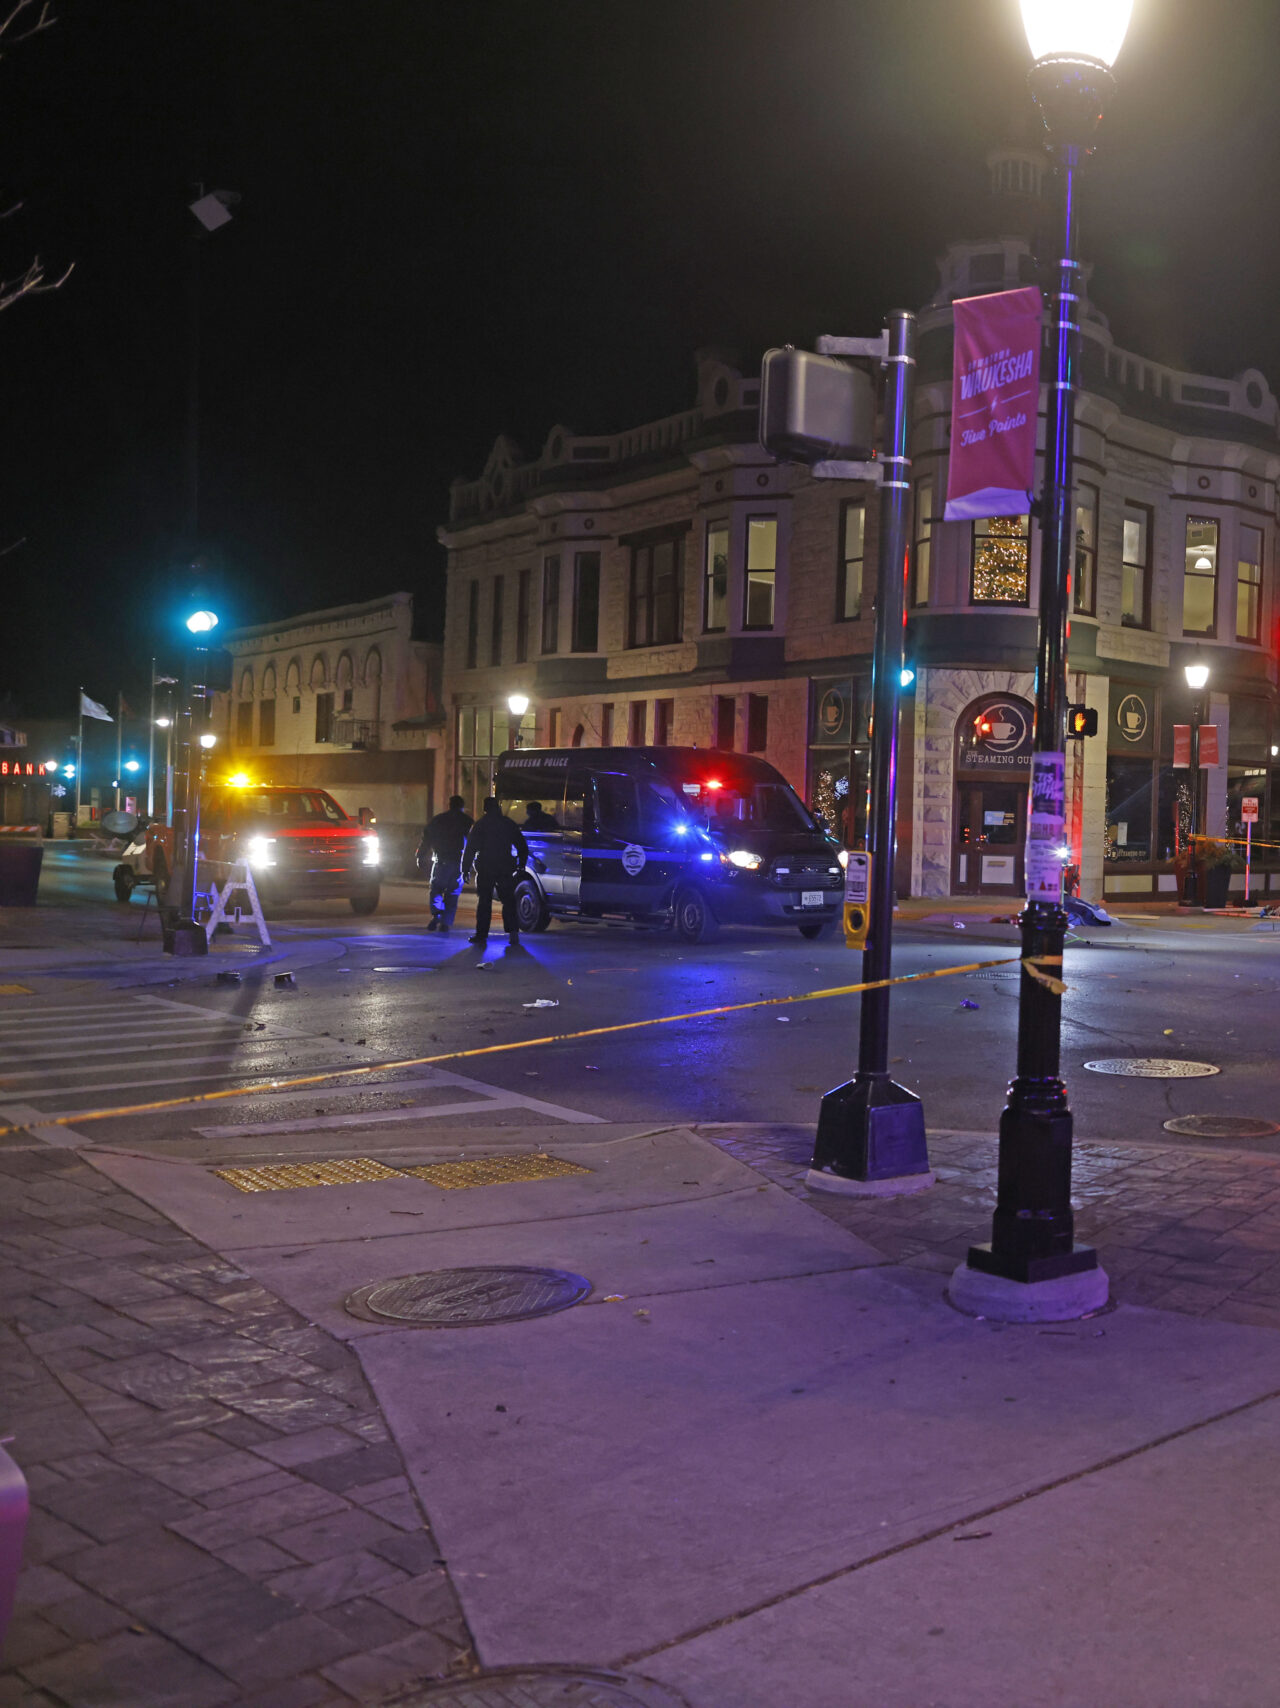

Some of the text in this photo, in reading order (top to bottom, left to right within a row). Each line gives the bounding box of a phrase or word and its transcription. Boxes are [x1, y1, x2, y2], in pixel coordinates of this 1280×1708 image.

[960, 350, 1033, 400] WAUKESHA
[960, 412, 1027, 447] Five Points
[504, 757, 568, 768] WAUKESHA POLICE
[966, 754, 1014, 764] STEAMING
[1, 761, 46, 776] BANK
